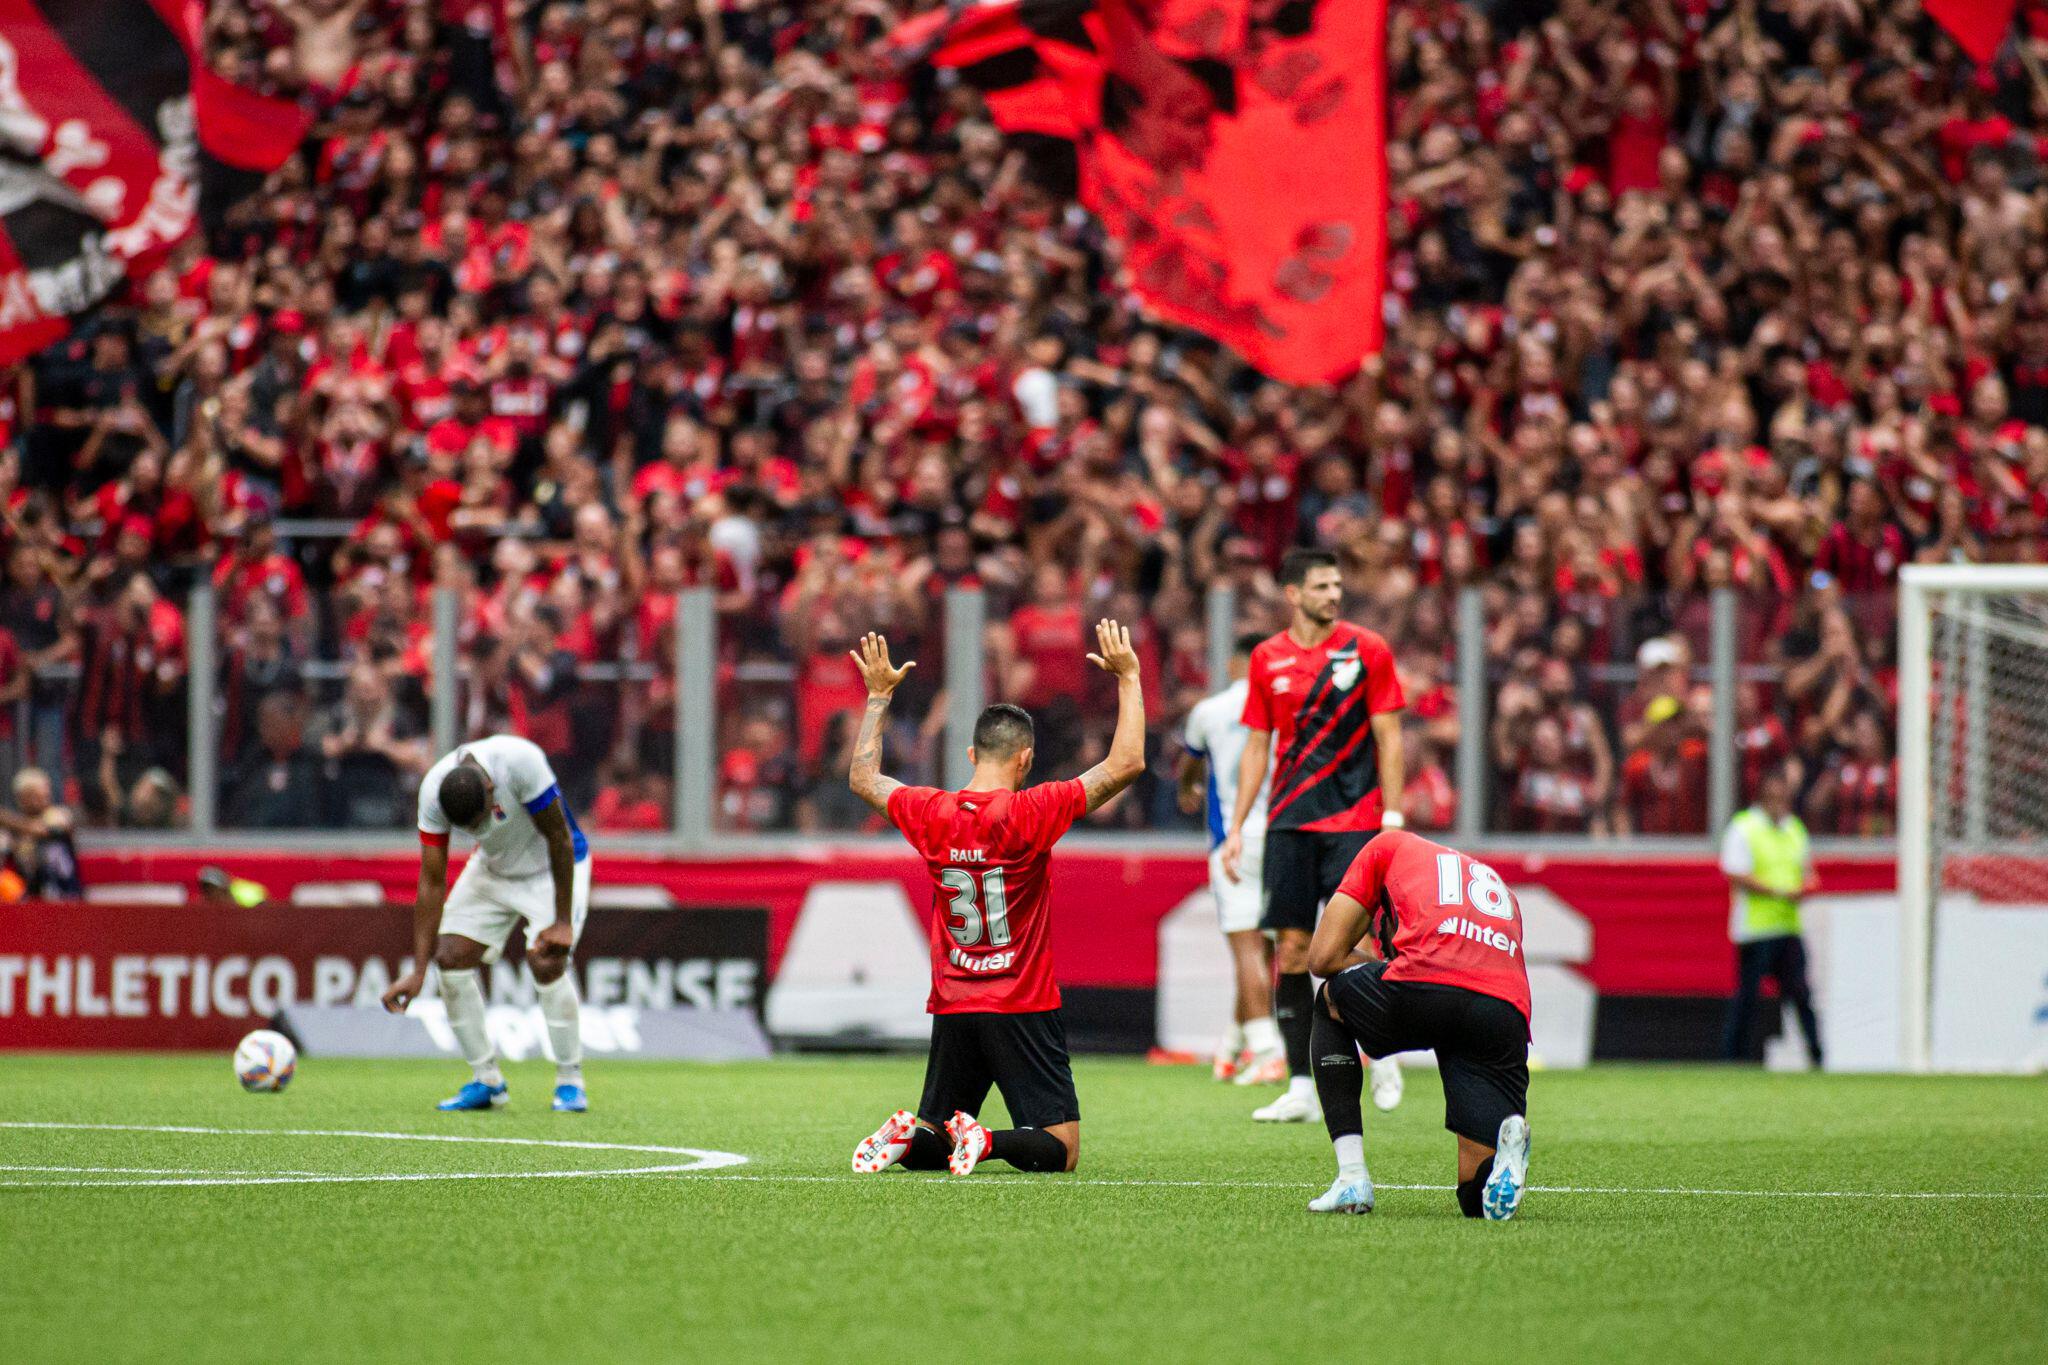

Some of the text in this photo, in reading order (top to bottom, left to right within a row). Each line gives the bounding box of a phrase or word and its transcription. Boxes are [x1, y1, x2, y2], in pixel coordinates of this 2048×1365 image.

[950, 848, 986, 863] RAUL
[941, 866, 1011, 947] 31
[1436, 853, 1514, 921] 18
[313, 956, 758, 1012] PANENSE
